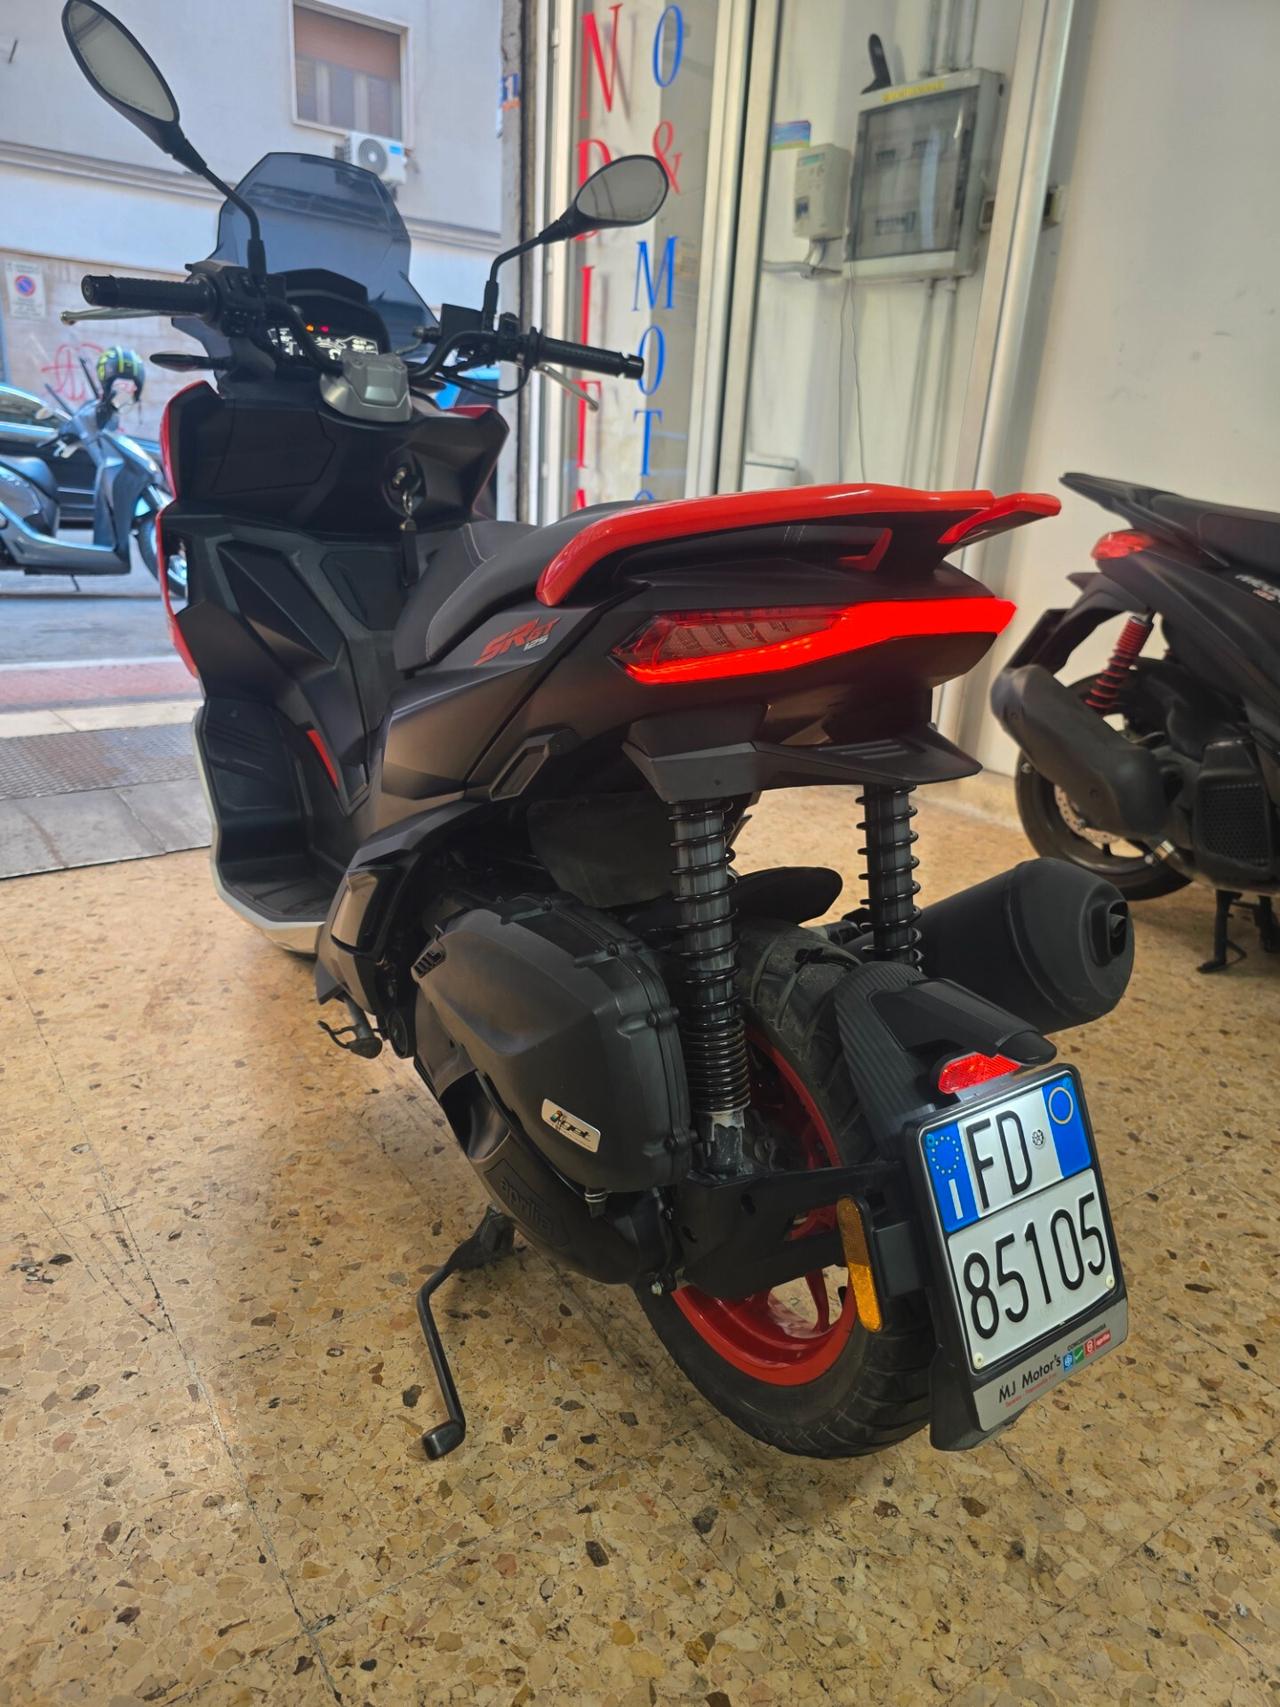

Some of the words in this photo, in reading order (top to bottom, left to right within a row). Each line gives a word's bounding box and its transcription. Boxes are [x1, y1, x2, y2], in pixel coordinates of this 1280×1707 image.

[632, 235, 679, 501] MOT
[966, 1110, 1033, 1209] FD
[963, 1192, 1106, 1340] 85105
[998, 1381, 1017, 1404] MJ
[1021, 1354, 1062, 1389] Motor's
